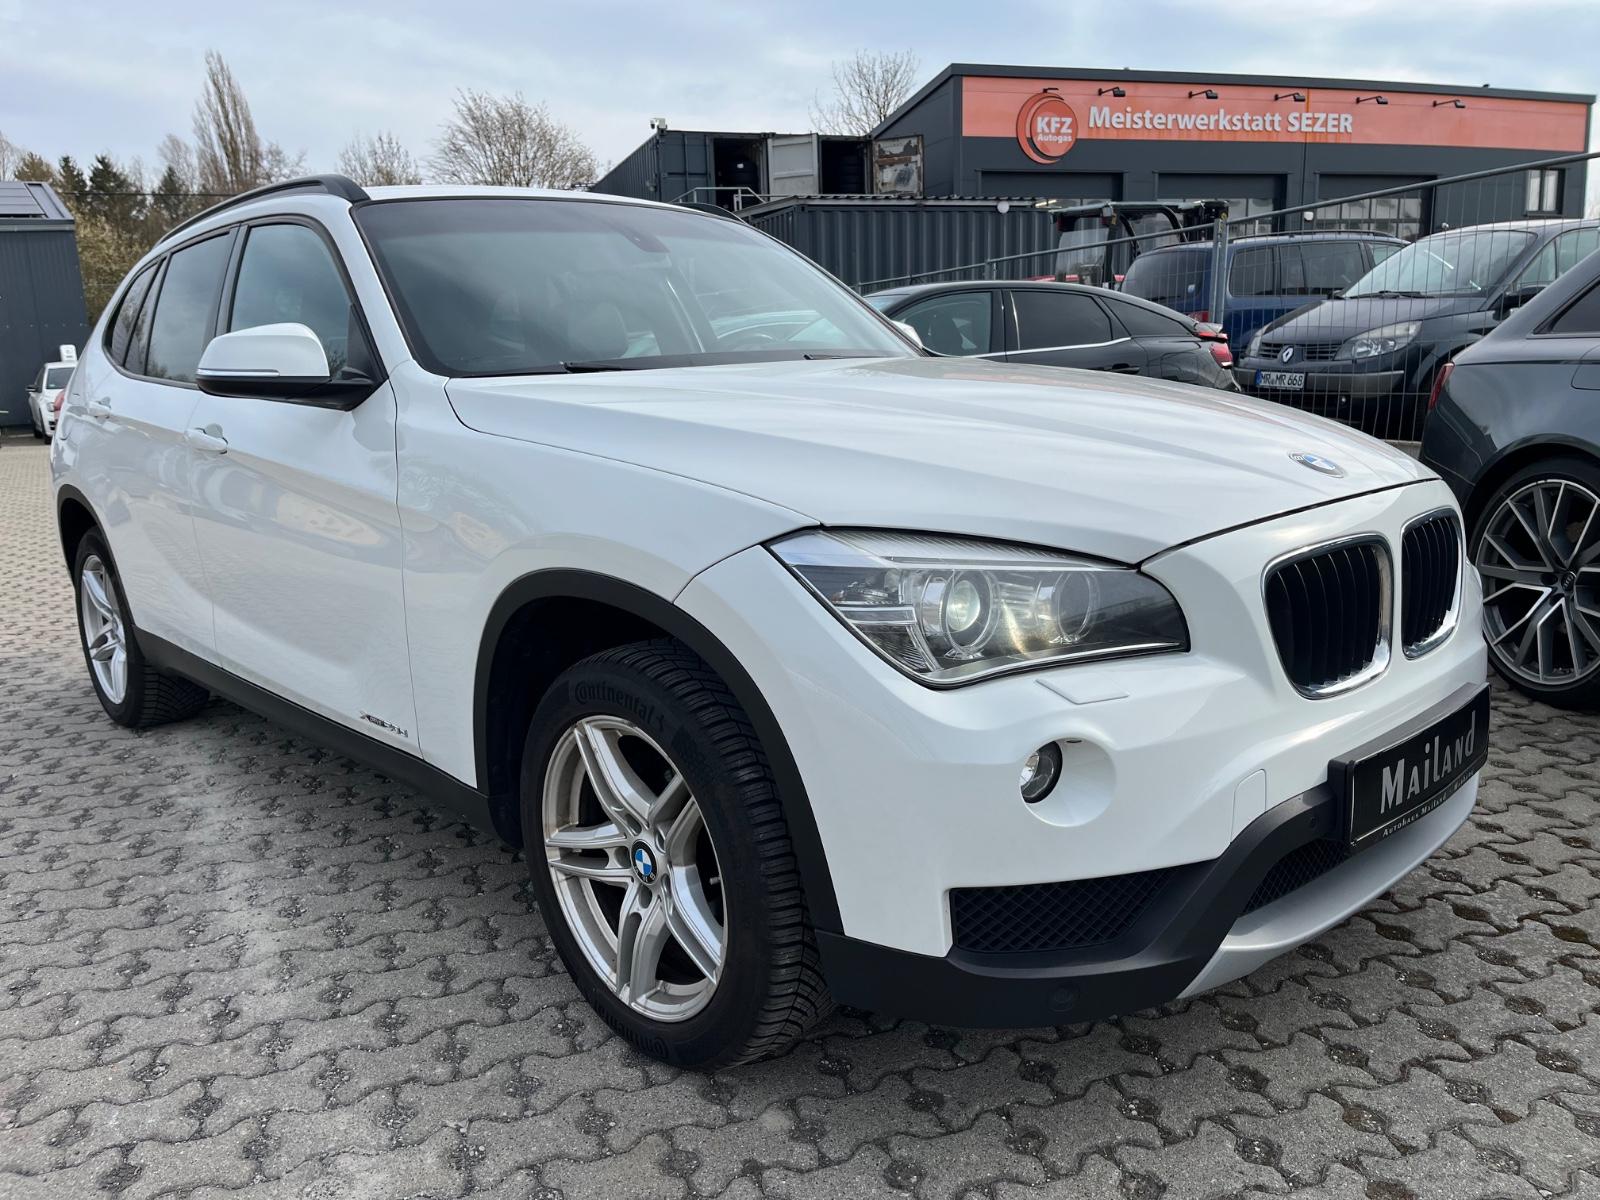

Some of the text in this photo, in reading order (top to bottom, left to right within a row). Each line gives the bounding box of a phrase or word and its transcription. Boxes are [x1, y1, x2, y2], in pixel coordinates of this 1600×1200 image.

[1037, 116, 1072, 133] KFZ
[1088, 106, 1352, 133] Meisterwerkstatt SEZER
[1037, 134, 1072, 144] Autogas
[574, 680, 655, 725] Continental
